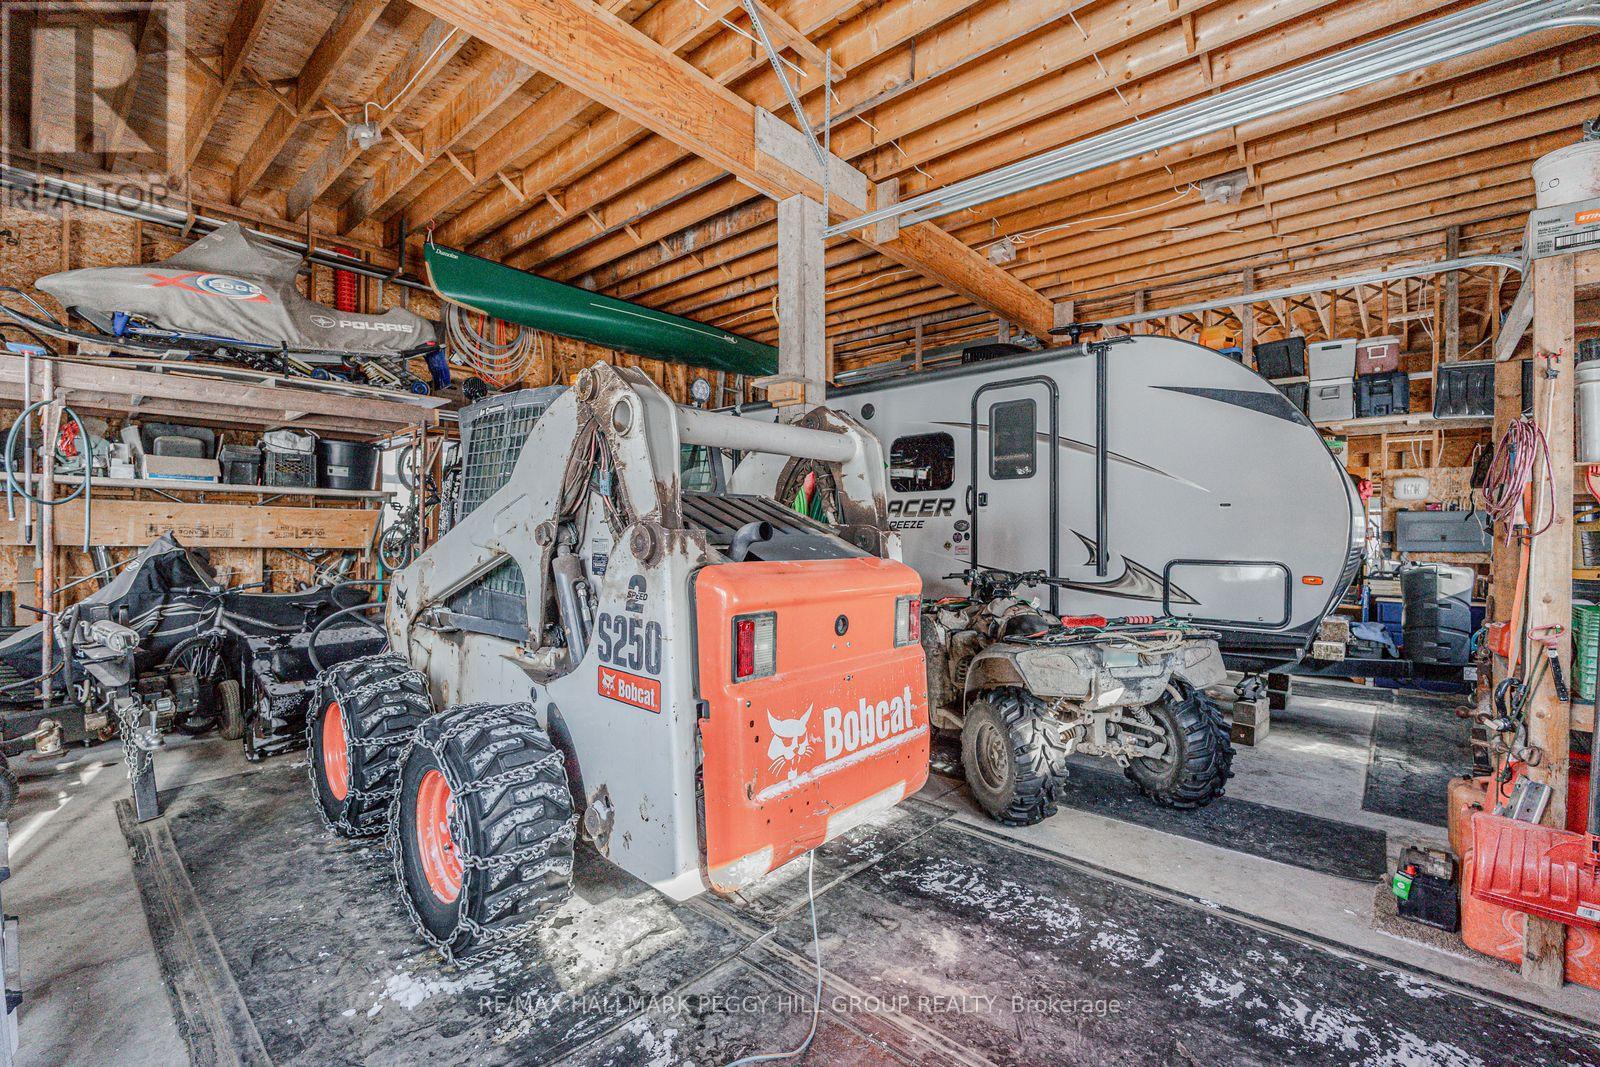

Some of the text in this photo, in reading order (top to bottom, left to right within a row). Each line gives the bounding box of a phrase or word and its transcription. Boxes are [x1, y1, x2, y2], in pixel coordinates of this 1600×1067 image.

[340, 320, 414, 333] POLARIS
[627, 590, 648, 601] SPEED
[598, 612, 662, 676] S250
[618, 678, 655, 708] Bobcat
[824, 686, 913, 761] Bobcat
